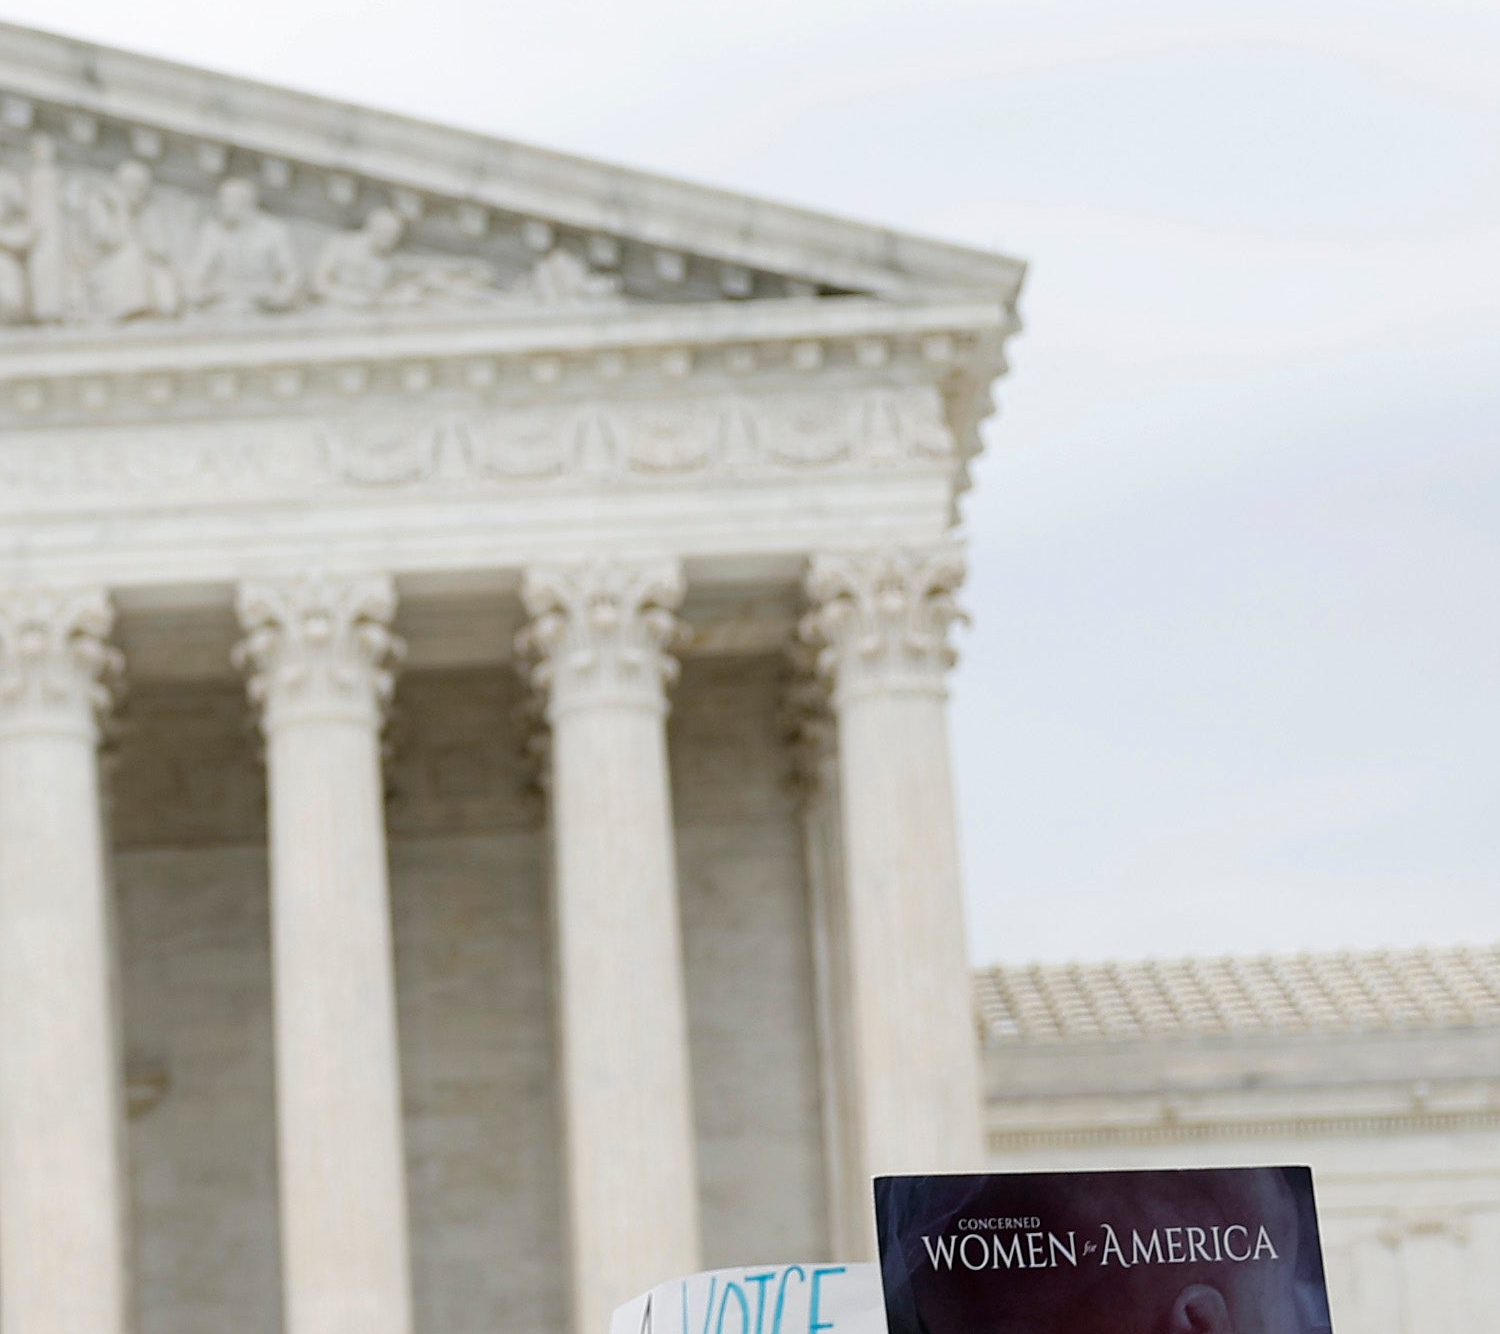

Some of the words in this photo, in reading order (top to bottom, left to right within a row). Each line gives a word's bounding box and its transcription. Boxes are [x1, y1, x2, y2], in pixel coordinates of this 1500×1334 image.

[958, 1216, 1041, 1231] CONCERNED
[921, 1230, 1078, 1271] WOMEN
[1100, 1223, 1280, 1268] AMERICA
